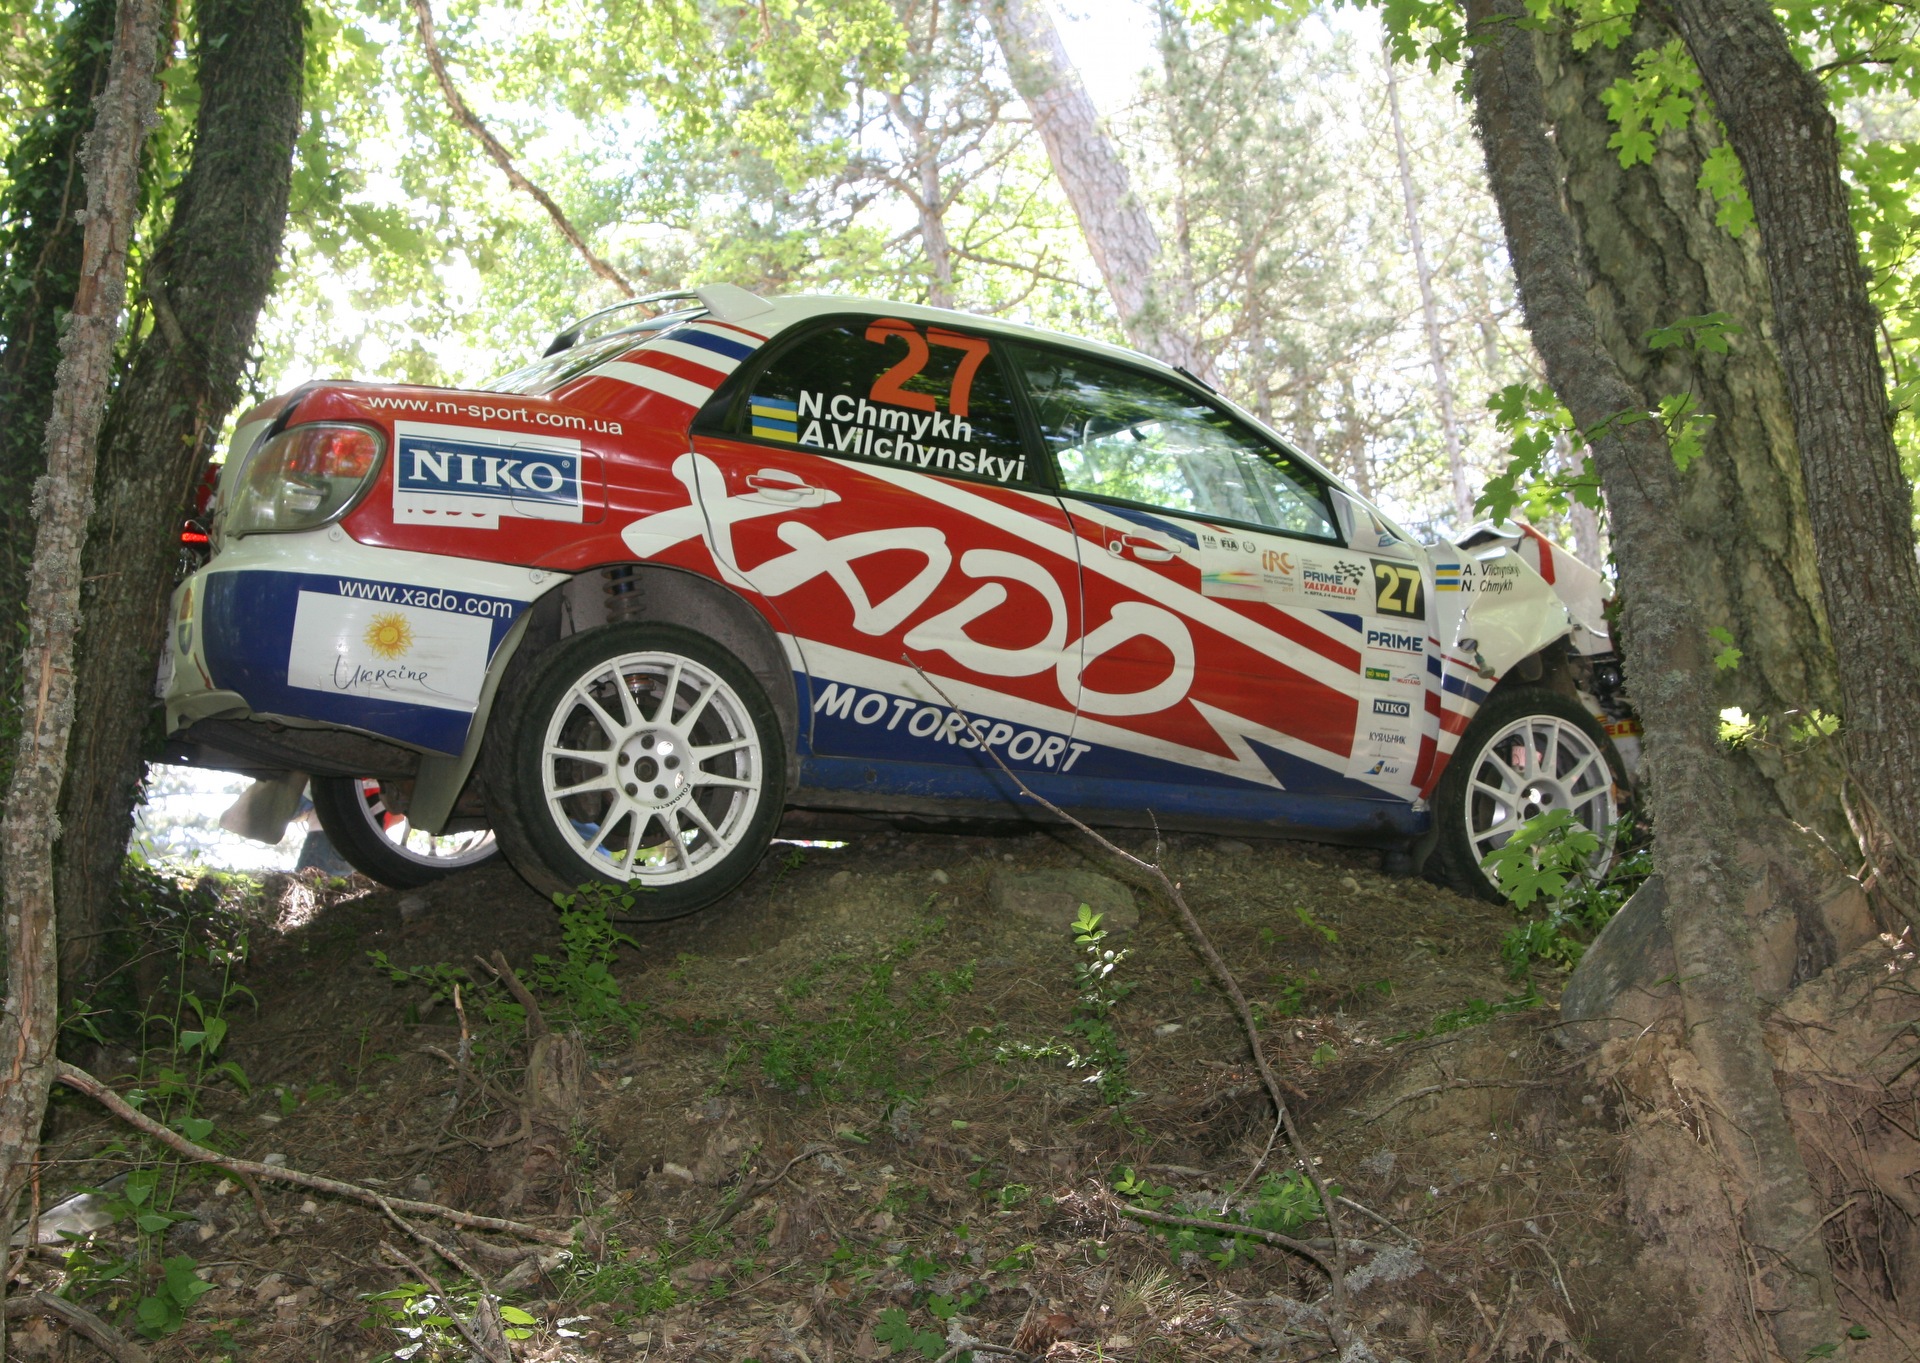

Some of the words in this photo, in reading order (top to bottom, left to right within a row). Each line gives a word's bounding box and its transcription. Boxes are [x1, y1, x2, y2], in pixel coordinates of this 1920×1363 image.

[864, 318, 990, 417] 27
[367, 396, 624, 436] www.m-sport.com.ua
[798, 389, 972, 442] N.Chmykh
[408, 448, 564, 492] NIKO
[799, 421, 1027, 482] A.Vilchynskyi
[1221, 538, 1238, 550] FIA
[1304, 571, 1343, 585] PRIME
[1375, 564, 1420, 613] 27
[1461, 579, 1475, 592] N.
[1462, 563, 1476, 576] A.
[338, 580, 513, 619] www.xado.com
[1368, 631, 1423, 651] PRIME
[1375, 701, 1408, 715] NIKO
[813, 684, 1095, 774] MOTORSPORT
